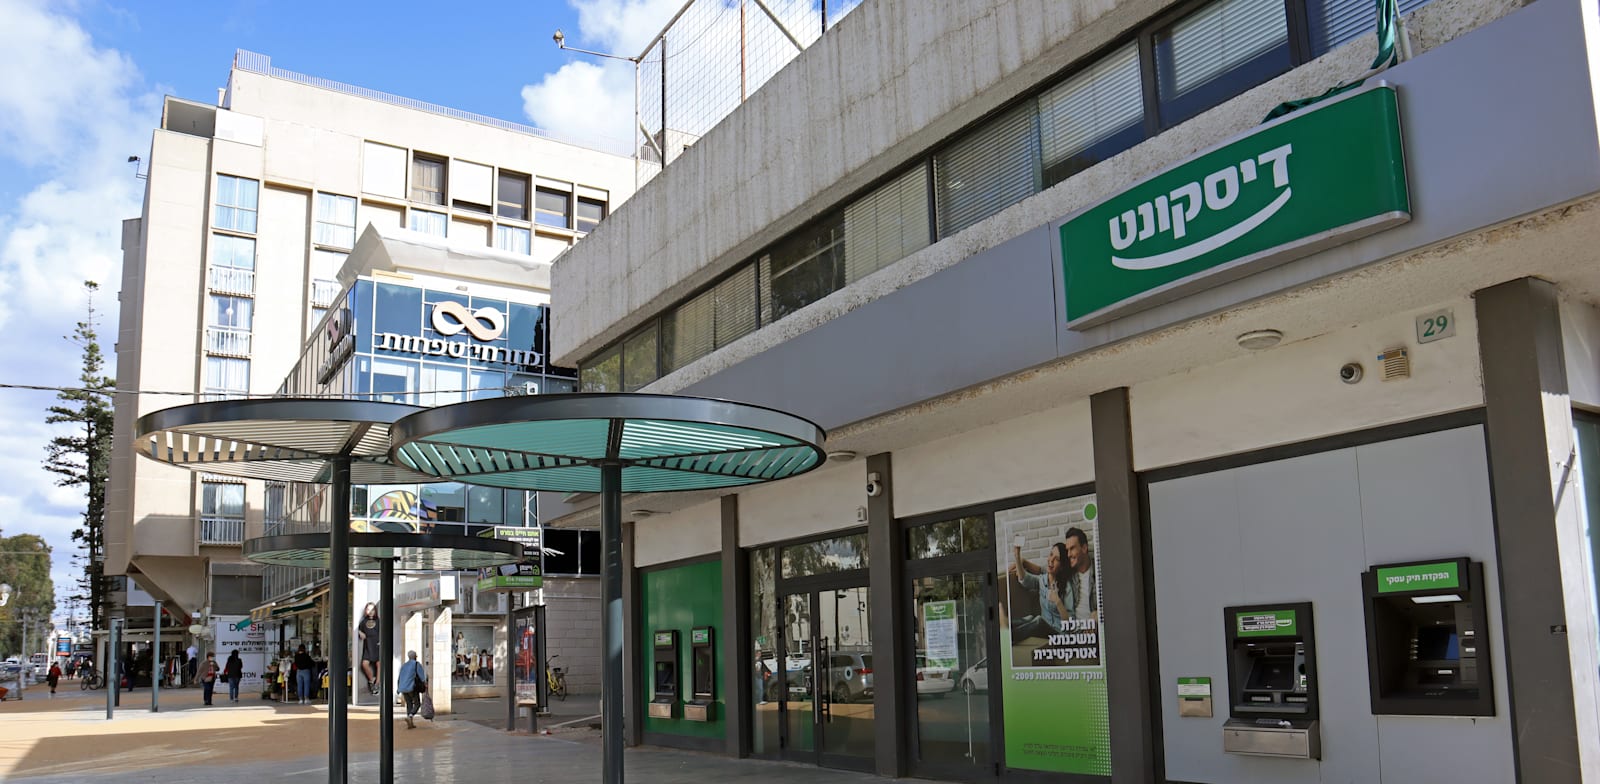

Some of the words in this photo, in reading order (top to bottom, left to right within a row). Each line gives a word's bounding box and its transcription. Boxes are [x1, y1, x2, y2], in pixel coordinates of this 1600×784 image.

[1109, 143, 1293, 250] דיסקונט
[1423, 315, 1448, 337] 29
[380, 332, 466, 358] טפחות
[1386, 576, 1405, 585] עסקי
[1406, 575, 1420, 584] תיק
[1422, 572, 1449, 581] הפקדת
[1060, 616, 1096, 631] חבילת
[1048, 632, 1097, 646] משכנתא
[1033, 647, 1097, 663] אטרקטיבית
[1036, 671, 1079, 680] משכנתאות
[1081, 671, 1103, 682] מוקד
